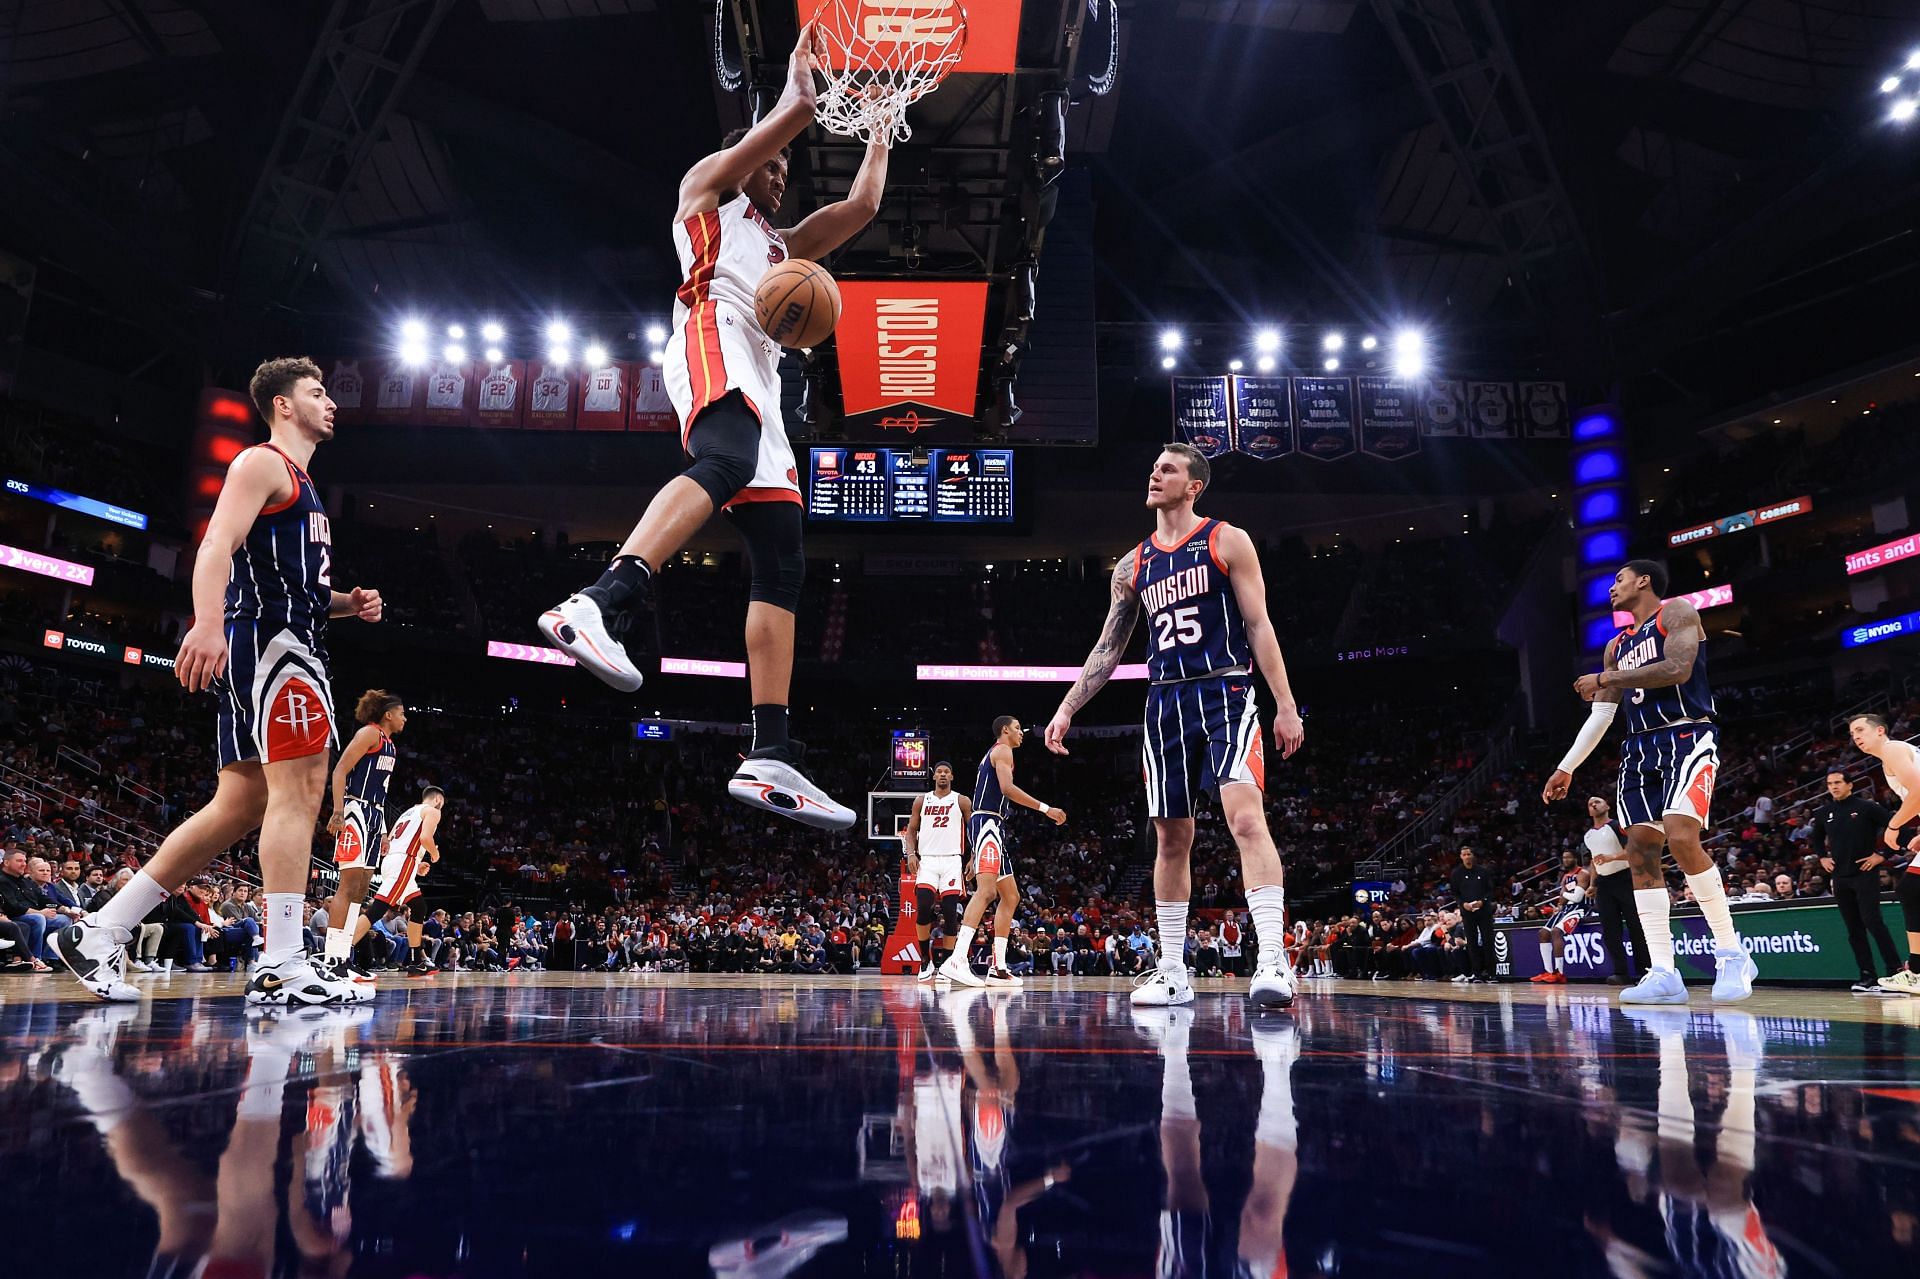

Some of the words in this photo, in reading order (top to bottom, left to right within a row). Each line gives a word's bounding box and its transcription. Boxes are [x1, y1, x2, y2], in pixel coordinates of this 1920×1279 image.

[876, 299, 939, 396] HOUSTON
[437, 382, 455, 394] 24
[490, 384, 506, 396] 22
[542, 385, 559, 397] 34
[651, 380, 660, 392] 11
[1251, 399, 1276, 408] 1998
[1312, 399, 1336, 408] 1999
[1376, 399, 1400, 407] 2000
[1186, 409, 1217, 418] WNBA
[1248, 408, 1279, 417] WNBA
[1309, 410, 1340, 418] WNBA
[1374, 409, 1404, 417] WNBA
[1177, 418, 1227, 429] Champions
[1238, 418, 1289, 429] Champions
[1300, 419, 1350, 429] Champions
[1365, 418, 1415, 429] Champions
[946, 453, 970, 461] HEAT
[856, 460, 876, 474] 43
[949, 461, 970, 475] 44
[6, 479, 30, 493] axs
[1671, 526, 1714, 544] CLUTCH'S
[1759, 502, 1800, 520] CORNER
[1186, 545, 1208, 553] karma
[1884, 538, 1915, 560] and
[65, 565, 88, 581] 2X
[1140, 565, 1209, 618] HOUSTON
[1154, 606, 1203, 652] 25
[1867, 622, 1902, 638] NYDIG
[66, 638, 106, 654] TOYOTA
[1348, 649, 1371, 660] and
[1375, 646, 1408, 657] More
[934, 667, 961, 678] Fuel
[963, 667, 999, 678] Points
[1002, 668, 1024, 679] and
[1028, 669, 1058, 680] More
[903, 741, 925, 752] 4:46
[924, 803, 954, 815] HEAT
[932, 816, 950, 828] 22
[1563, 932, 1605, 970] axs
[1670, 933, 1717, 956] ickets
[1735, 930, 1820, 953] oments.
[1495, 962, 1511, 976] AT&T
